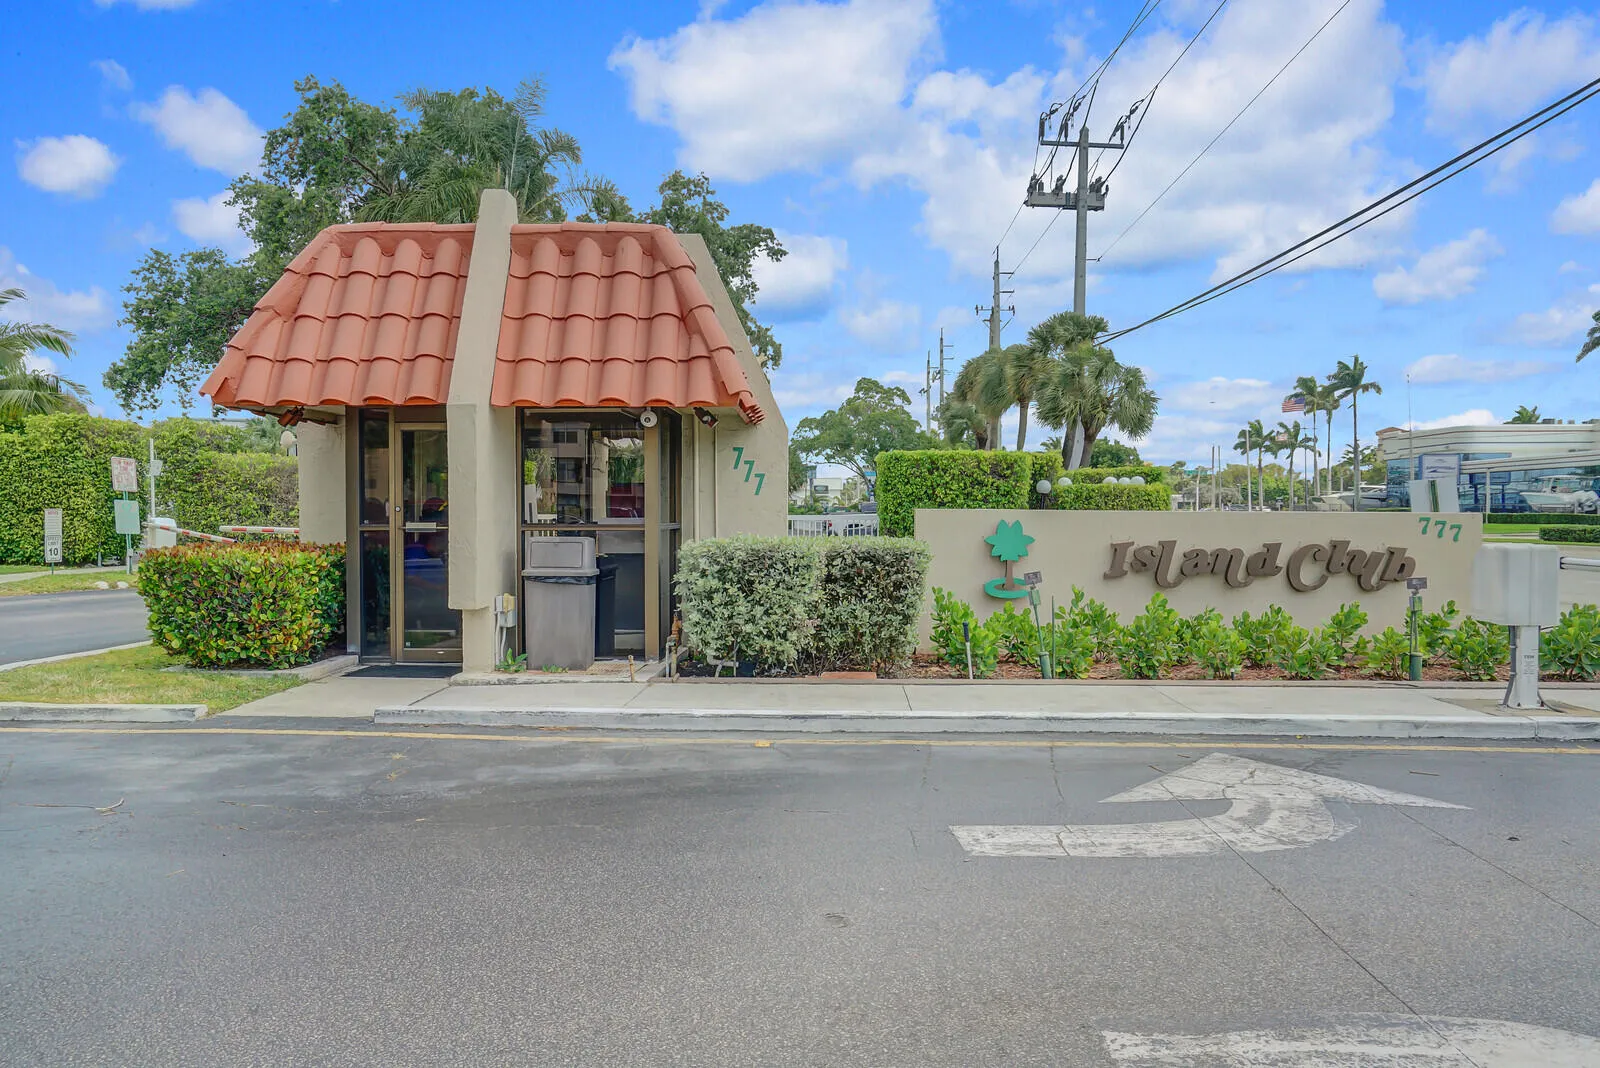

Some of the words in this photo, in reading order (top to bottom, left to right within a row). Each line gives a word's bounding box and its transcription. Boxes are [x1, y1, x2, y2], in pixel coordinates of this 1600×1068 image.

[732, 446, 766, 496] 777
[1418, 516, 1463, 542] 777
[49, 547, 59, 556] 10
[1103, 539, 1283, 588] Island
[1286, 540, 1416, 592] Club
